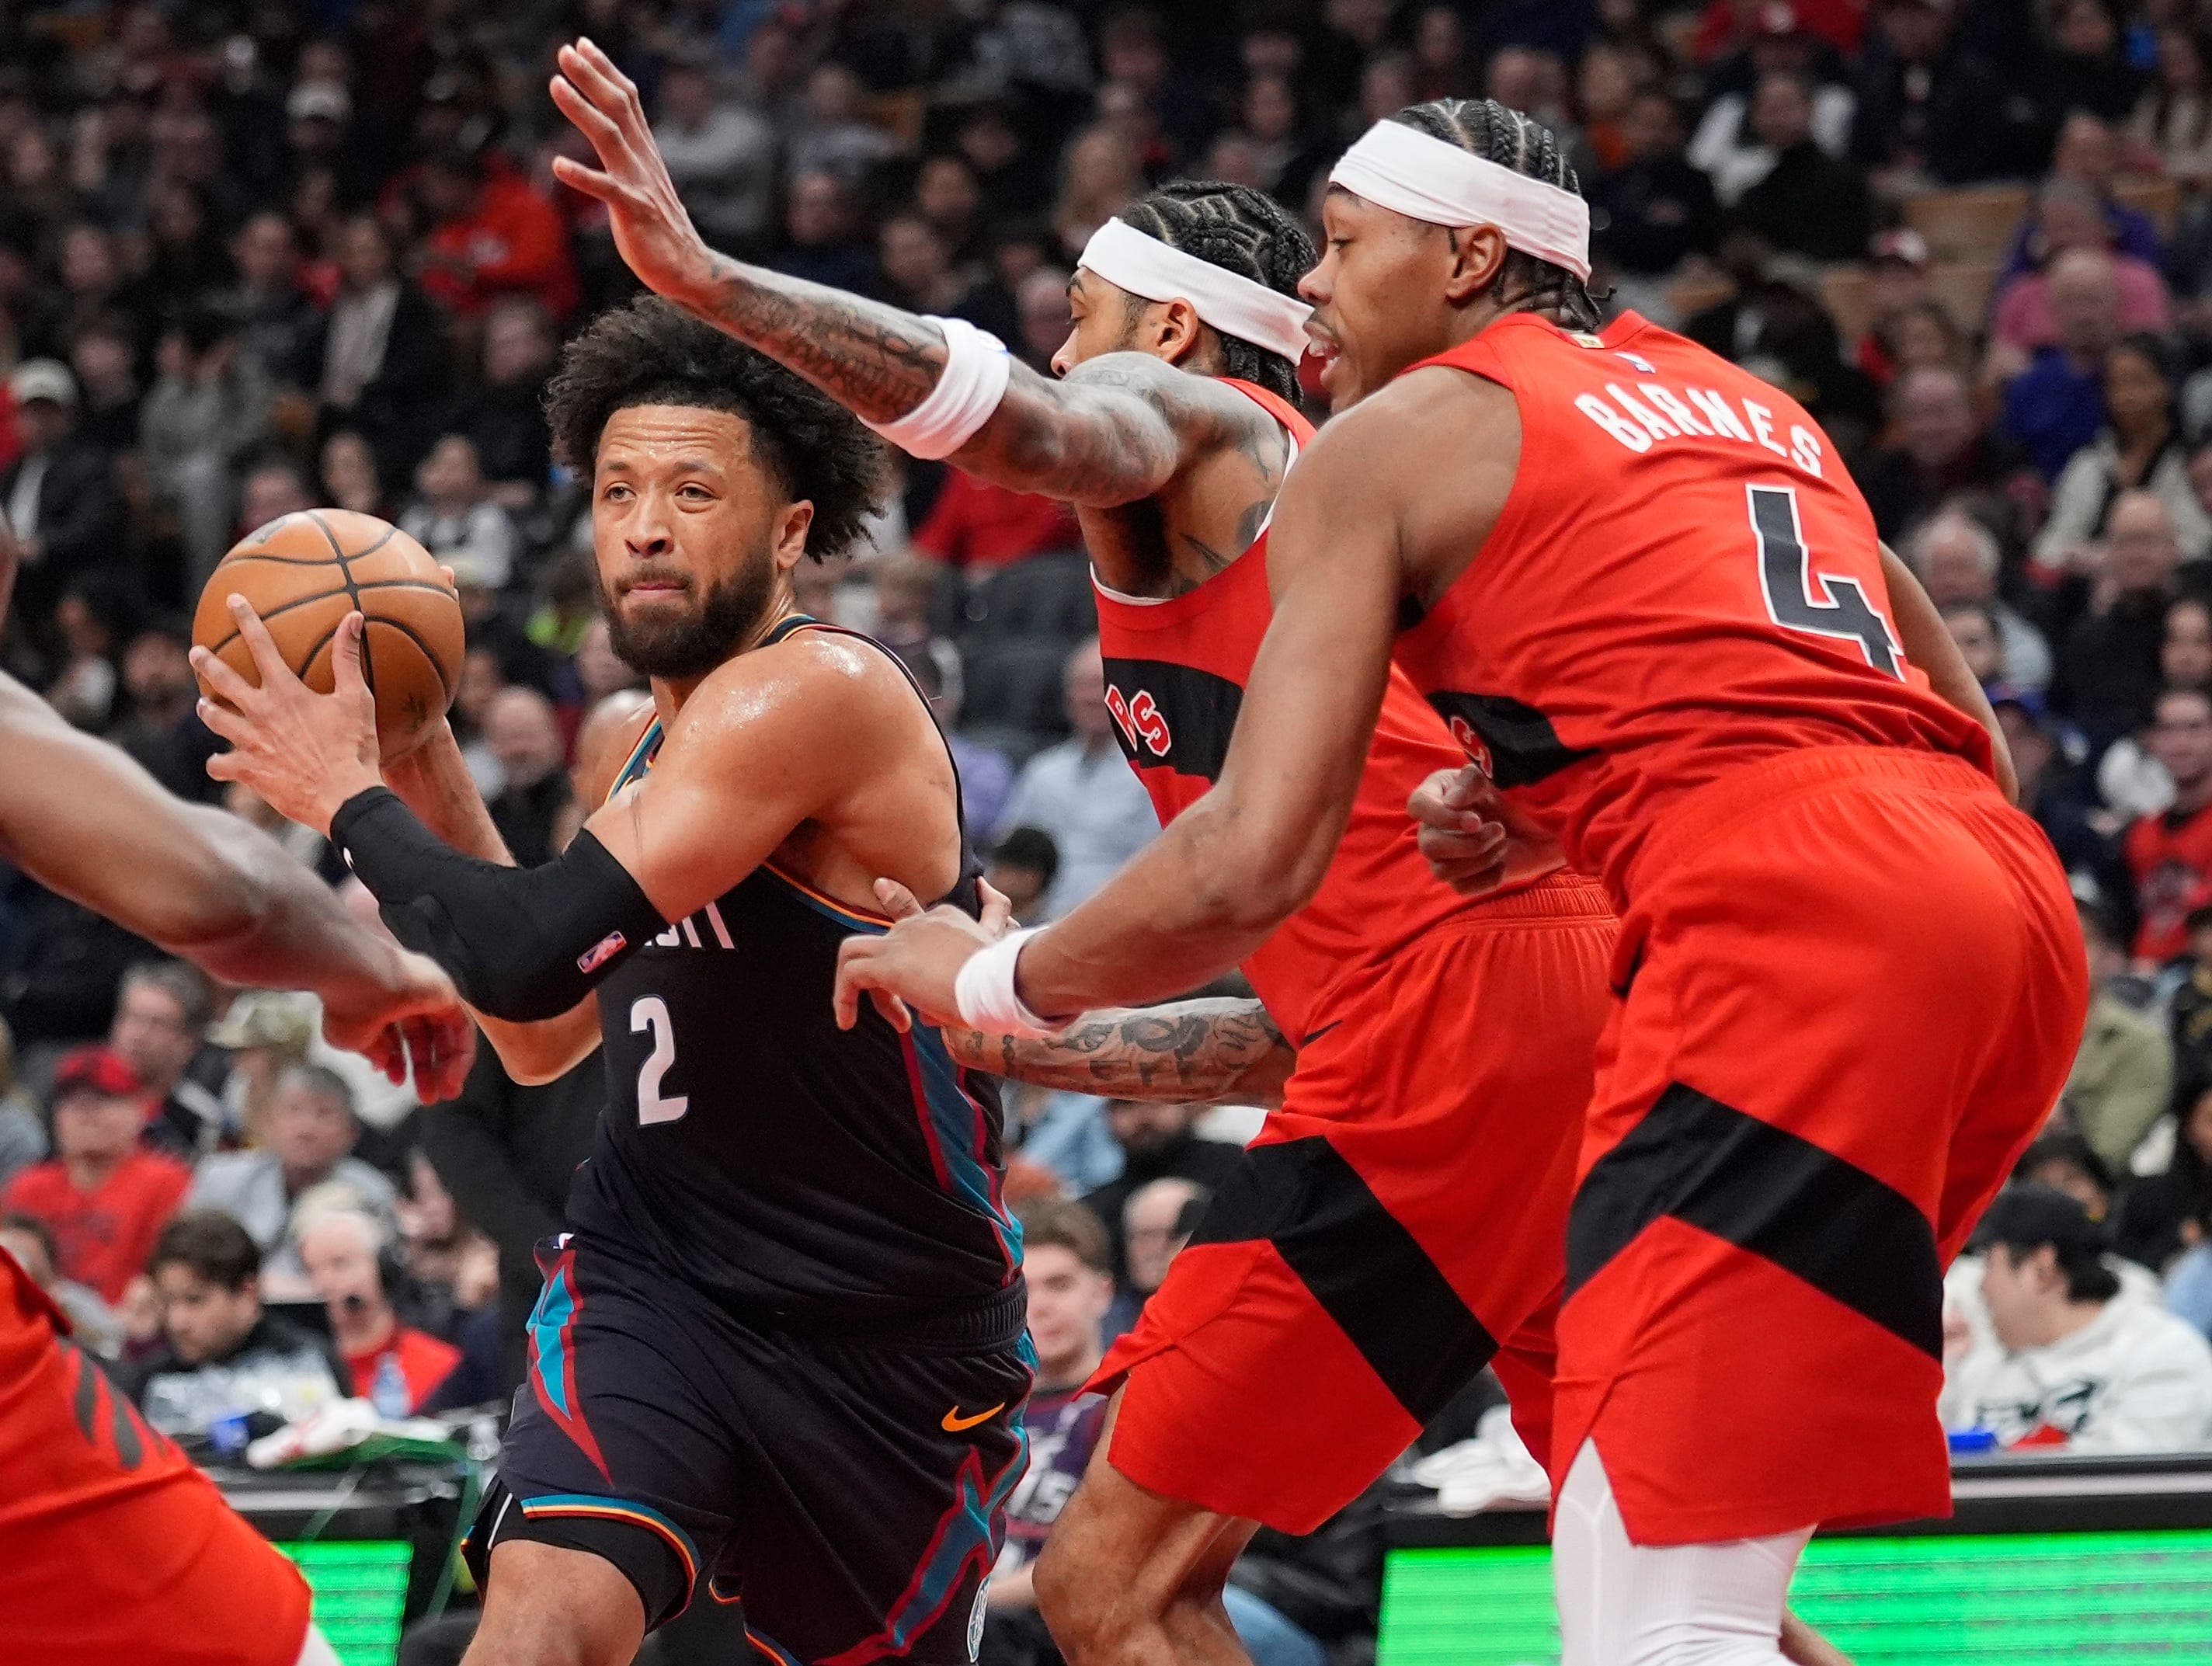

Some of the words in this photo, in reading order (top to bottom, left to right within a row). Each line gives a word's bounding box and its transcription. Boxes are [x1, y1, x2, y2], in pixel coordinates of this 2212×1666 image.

[1574, 382, 1823, 480] BARNES
[1744, 482, 1907, 684] 4
[629, 995, 690, 1126] 2
